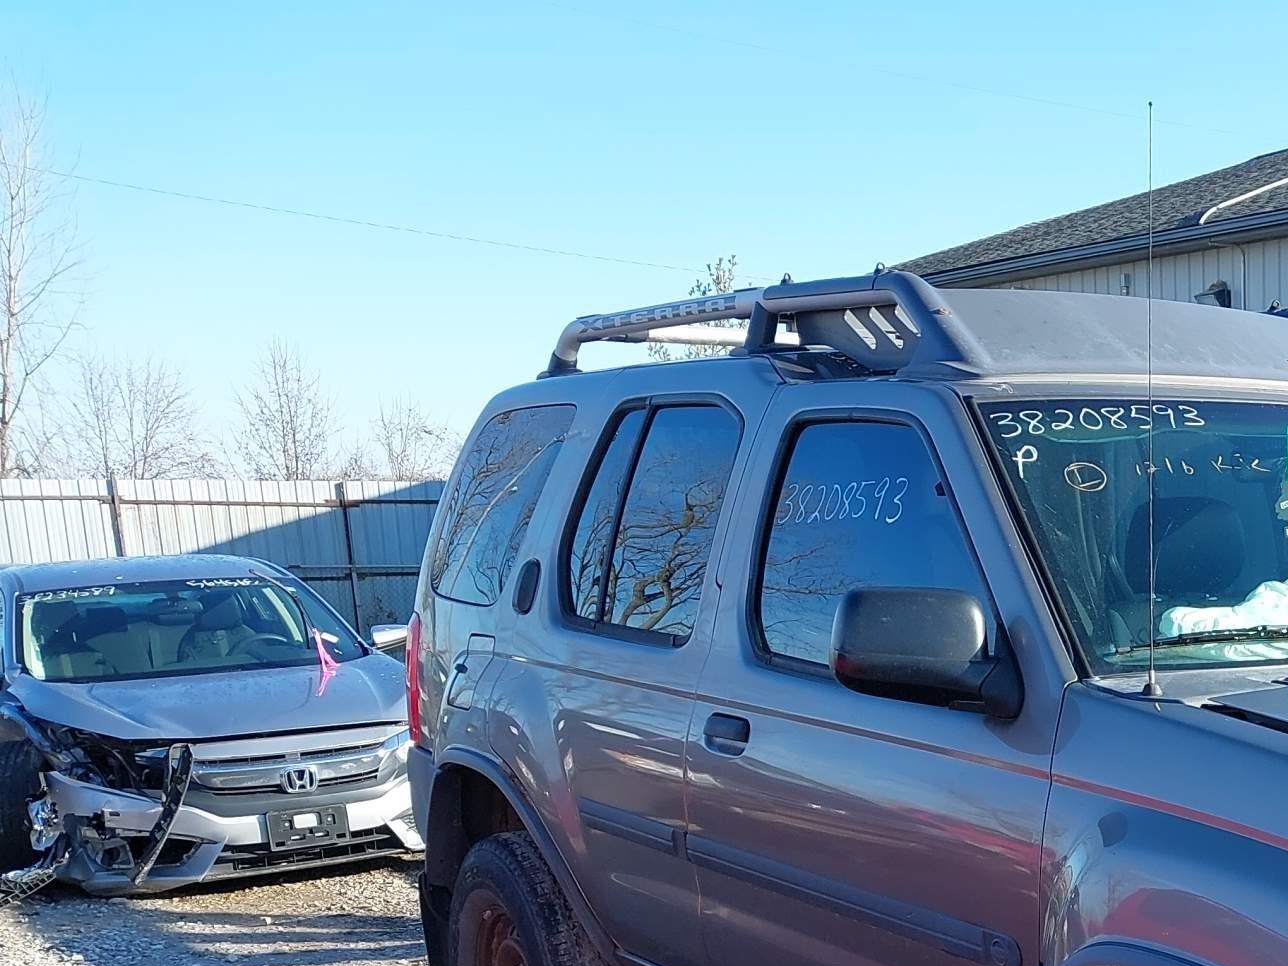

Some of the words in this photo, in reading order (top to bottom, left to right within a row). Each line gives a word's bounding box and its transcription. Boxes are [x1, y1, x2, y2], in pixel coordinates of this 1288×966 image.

[580, 298, 726, 333] XTERRA
[989, 404, 1206, 438] 38208593
[777, 476, 909, 525] 38208593
